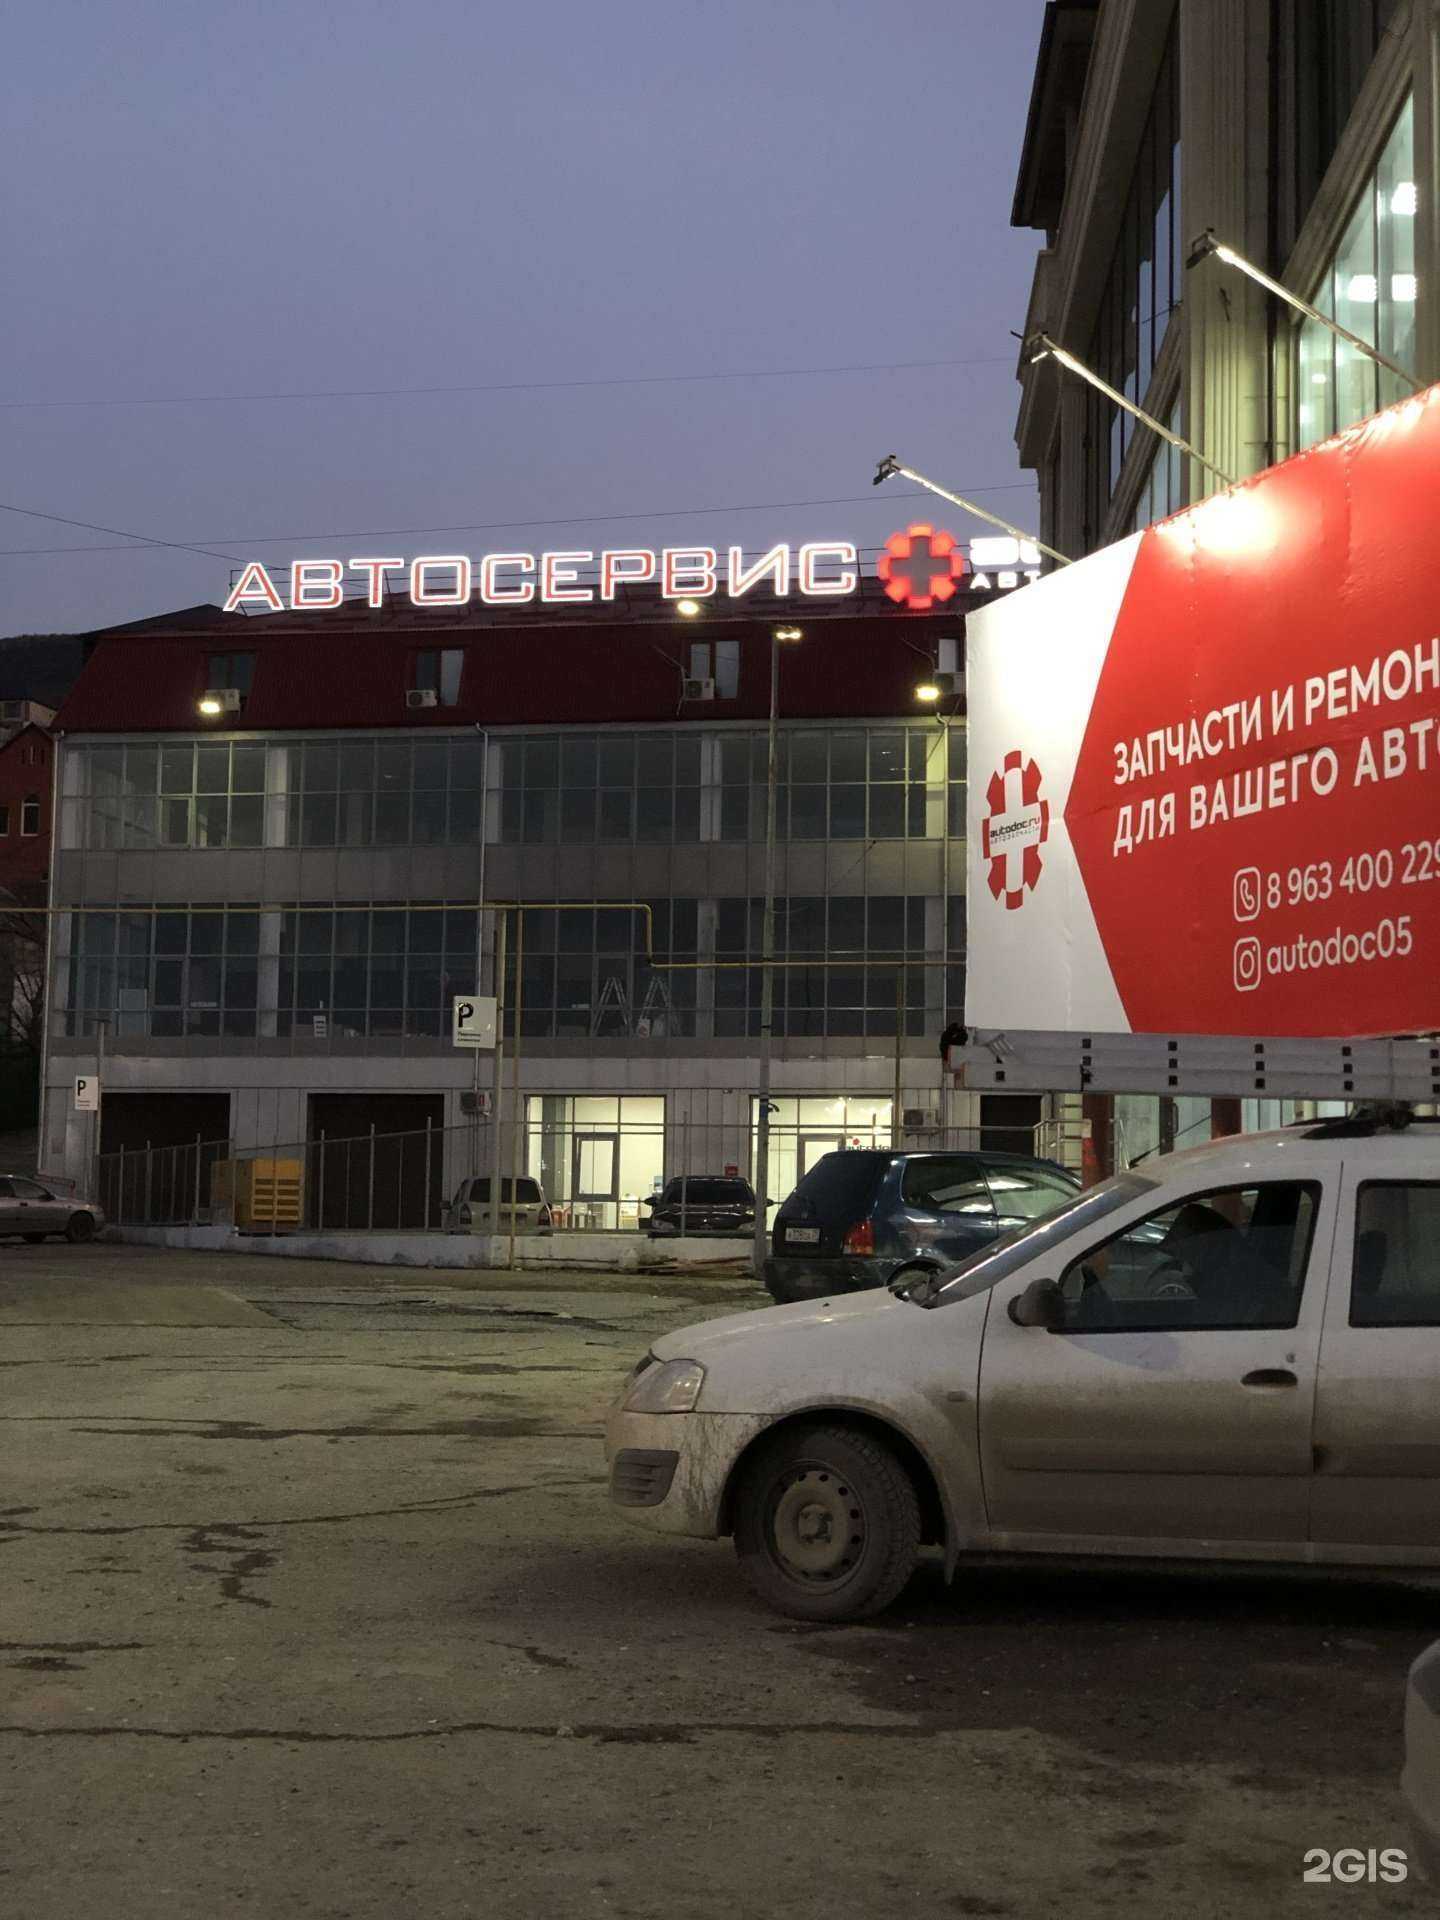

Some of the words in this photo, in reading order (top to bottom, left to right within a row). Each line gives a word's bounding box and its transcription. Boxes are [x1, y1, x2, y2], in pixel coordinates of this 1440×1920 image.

[222, 541, 857, 612] АВТОСЕРВИС
[1113, 696, 1263, 785] ЗАПЧАСТИ
[1271, 684, 1294, 736] И
[1112, 792, 1176, 858] ДЛЯ
[1189, 746, 1339, 830] ВАШЕГО
[1353, 717, 1440, 787] АВТ
[1266, 872, 1281, 909] 8
[1287, 861, 1333, 906] 963
[1339, 849, 1393, 894] 400
[1266, 915, 1413, 975] autodoc05
[458, 1002, 474, 1027] P
[77, 1079, 86, 1096] P
